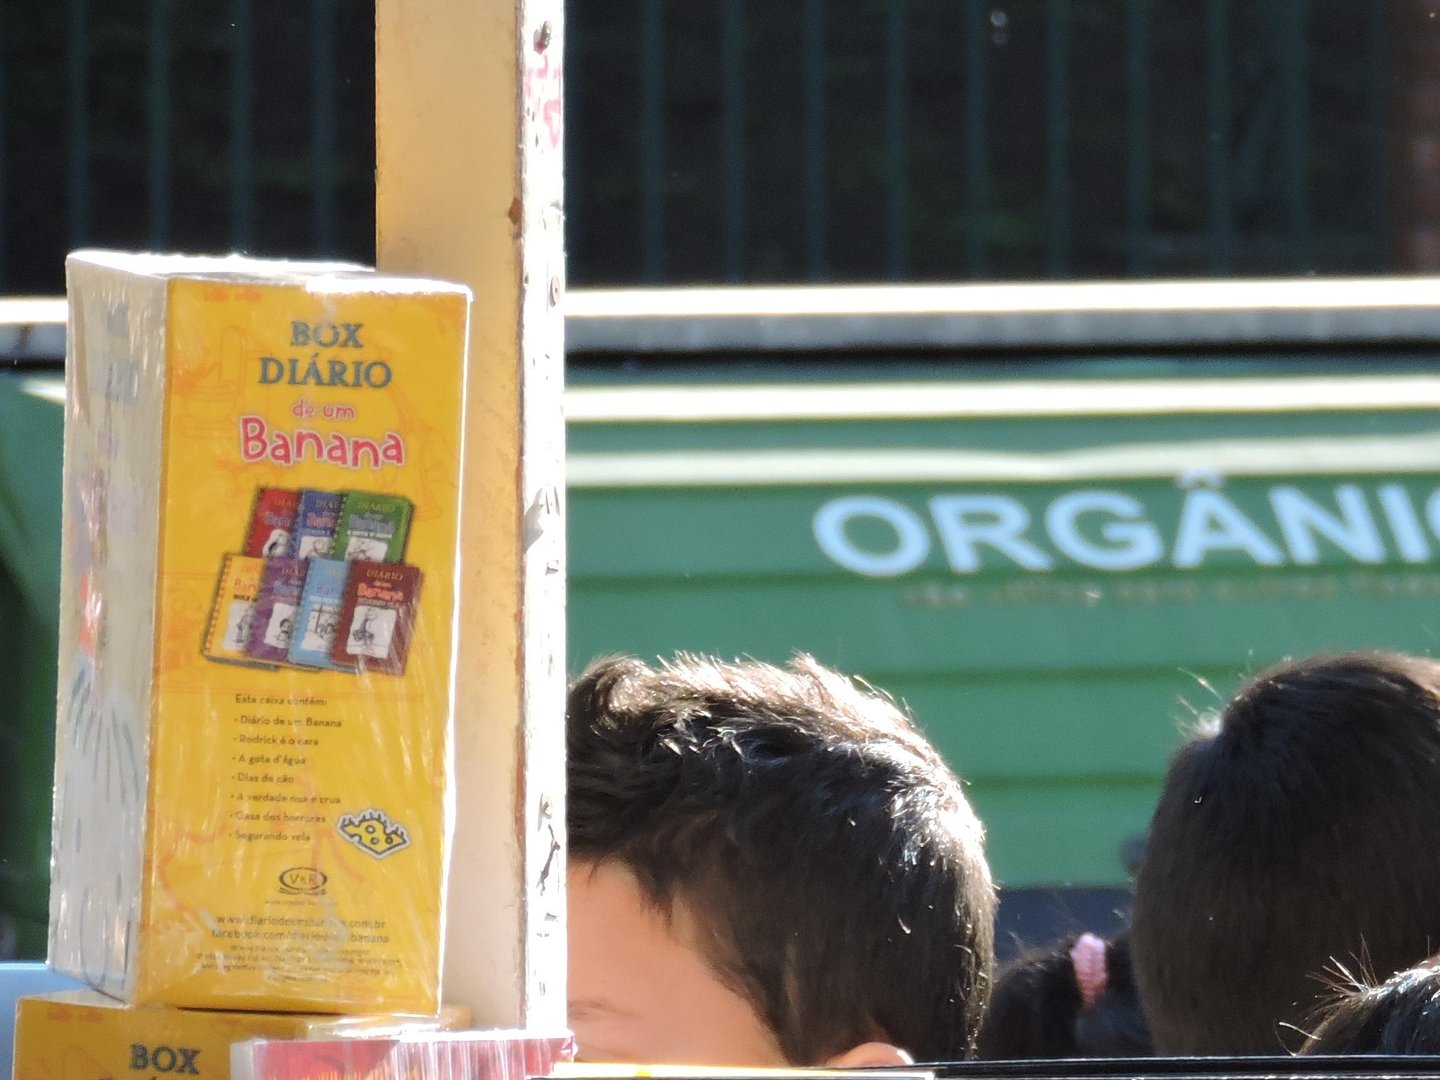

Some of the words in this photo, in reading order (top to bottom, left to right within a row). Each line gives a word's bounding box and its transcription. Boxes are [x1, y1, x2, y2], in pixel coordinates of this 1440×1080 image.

[290, 321, 365, 349] BOX
[258, 352, 393, 389] DIÁRIO
[293, 399, 315, 418] de
[322, 405, 355, 419] um
[239, 415, 405, 470] Banana
[235, 694, 257, 704] Este
[260, 697, 284, 705] caixa
[240, 714, 271, 726] Diário
[273, 716, 285, 726] de
[305, 717, 342, 728] Banana
[239, 734, 277, 745] Rodrick
[298, 738, 319, 747] cara
[248, 755, 270, 766] gota
[237, 772, 259, 783] Dias
[261, 773, 274, 783] de
[248, 793, 287, 803] verdade
[320, 796, 341, 804] crua
[263, 812, 280, 821] dos
[131, 1044, 201, 1075] BOX
